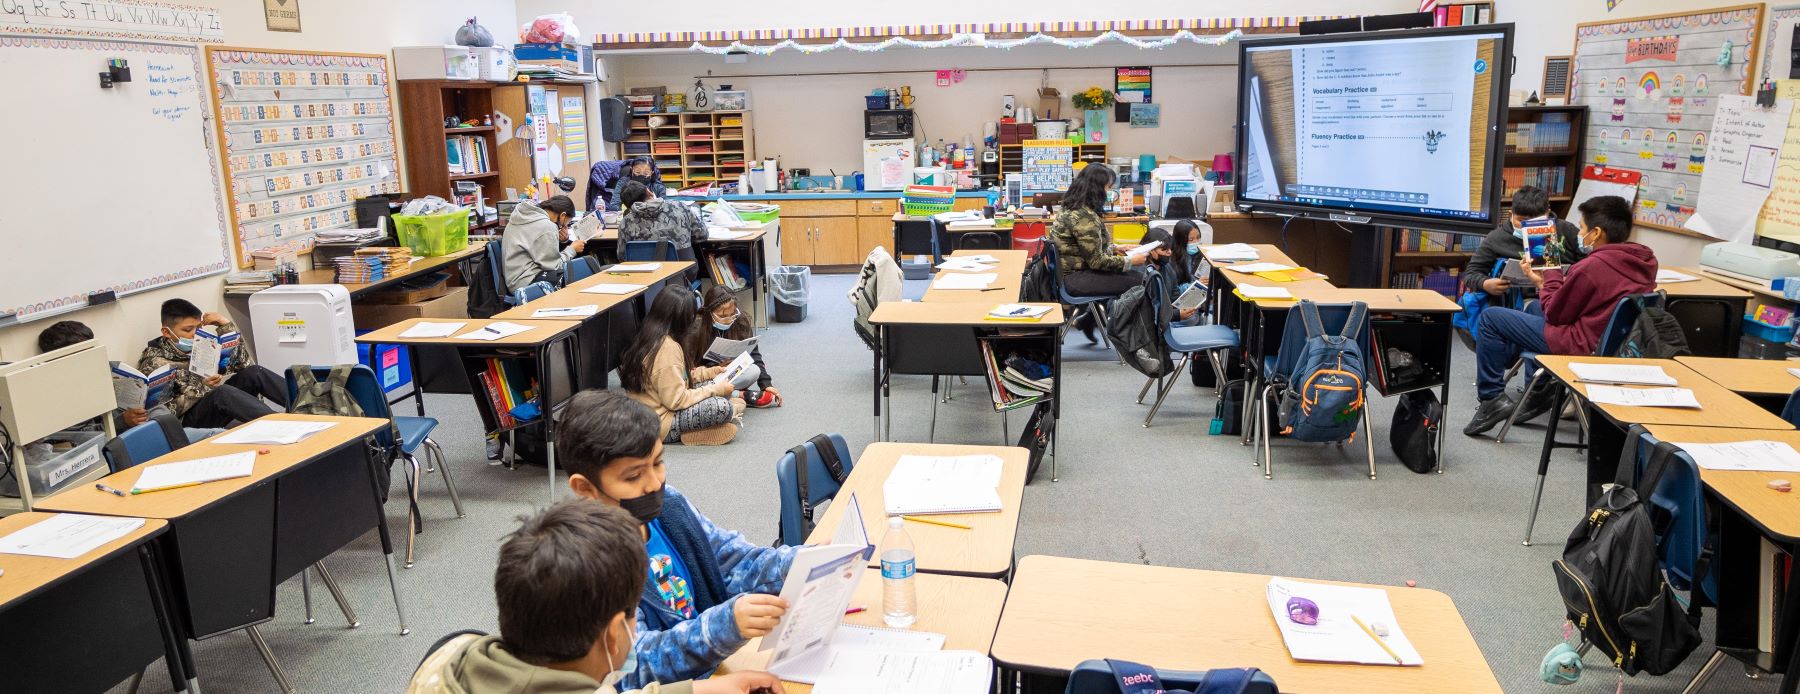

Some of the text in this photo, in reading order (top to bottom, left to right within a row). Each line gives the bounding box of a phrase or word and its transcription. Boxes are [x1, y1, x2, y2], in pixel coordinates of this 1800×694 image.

[33, 0, 50, 16] Rr
[61, 1, 76, 19] Ss
[81, 2, 97, 20] Tt
[104, 5, 122, 23] Uu
[127, 7, 143, 24] Vv
[148, 9, 168, 25] Ww
[190, 12, 204, 34] Yy
[208, 15, 220, 30] Zz
[1638, 41, 1677, 56] BIRTHDAYS
[55, 455, 94, 479] Mrs. Herrera
